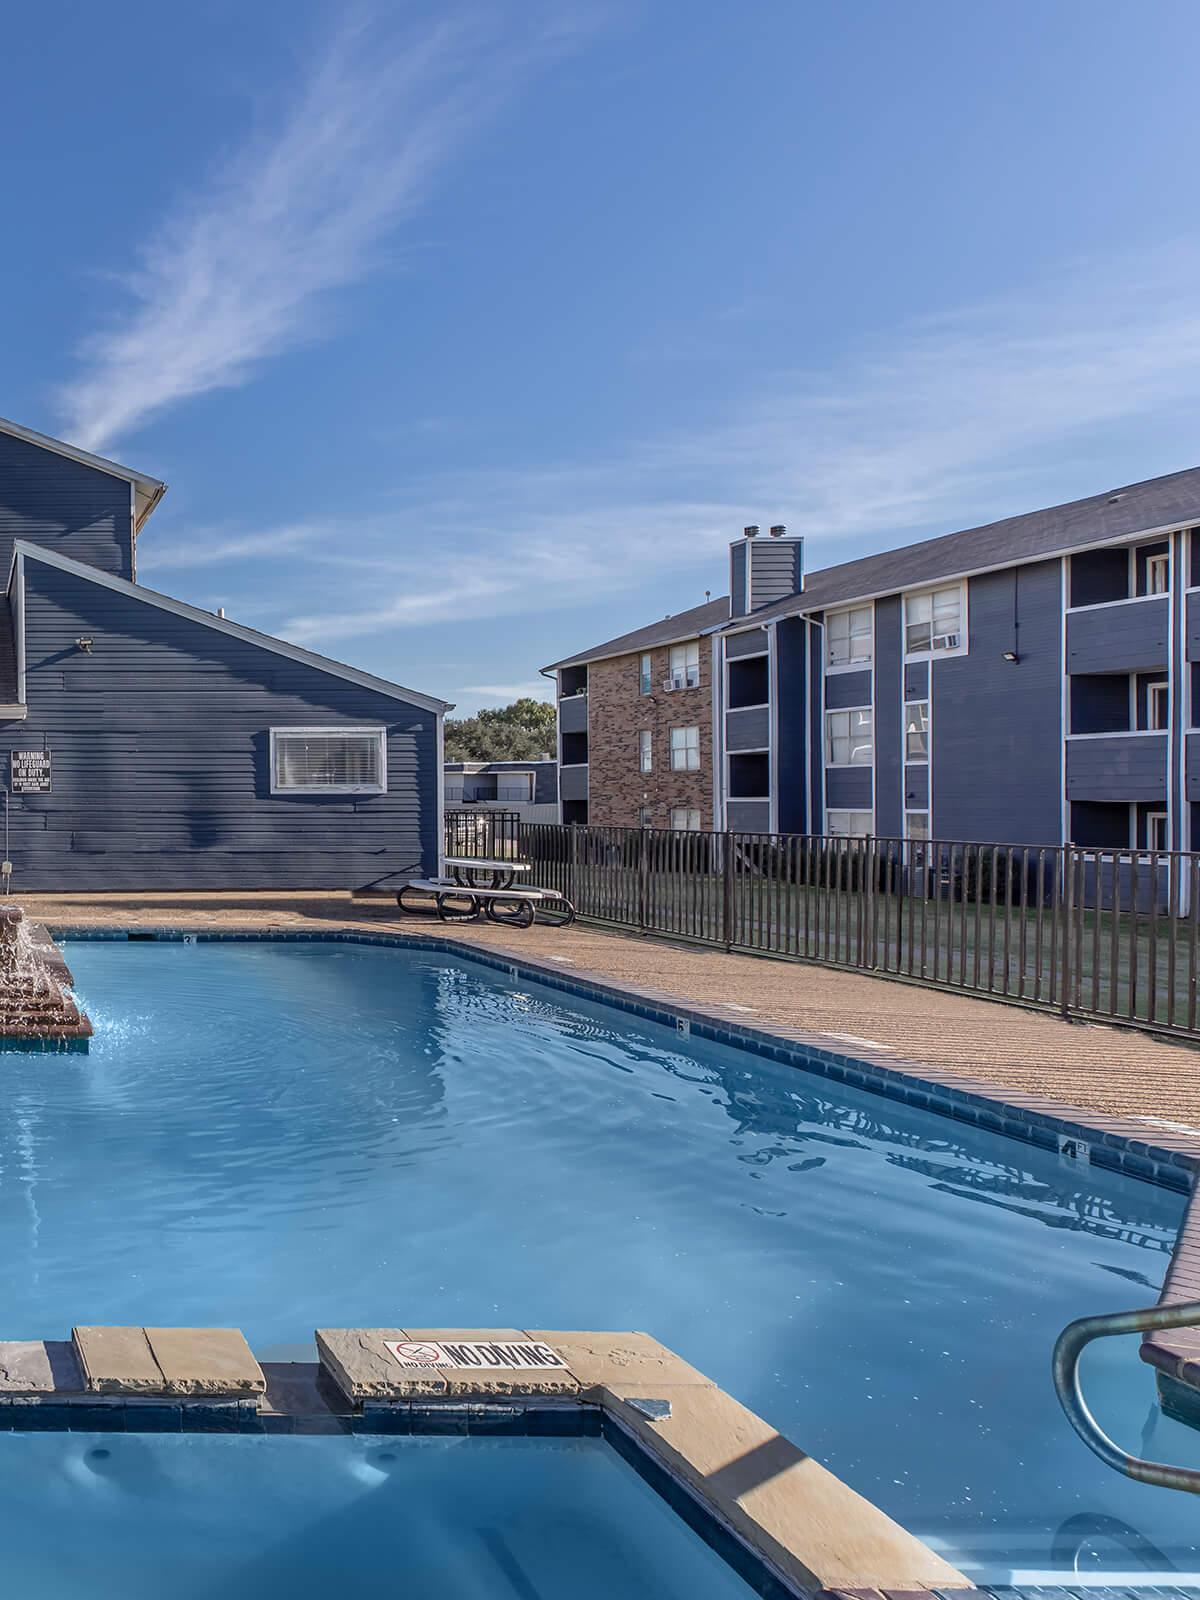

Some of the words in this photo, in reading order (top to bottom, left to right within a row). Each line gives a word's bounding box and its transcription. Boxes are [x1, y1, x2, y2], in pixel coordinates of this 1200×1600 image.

[18, 752, 44, 760] WARNING
[12, 760, 20, 768] NO
[21, 760, 50, 768] LIFEGUARD
[1061, 1140, 1078, 1159] 4
[1078, 1142, 1088, 1153] FT
[442, 1344, 480, 1366] NO
[478, 1343, 562, 1366] DIVING
